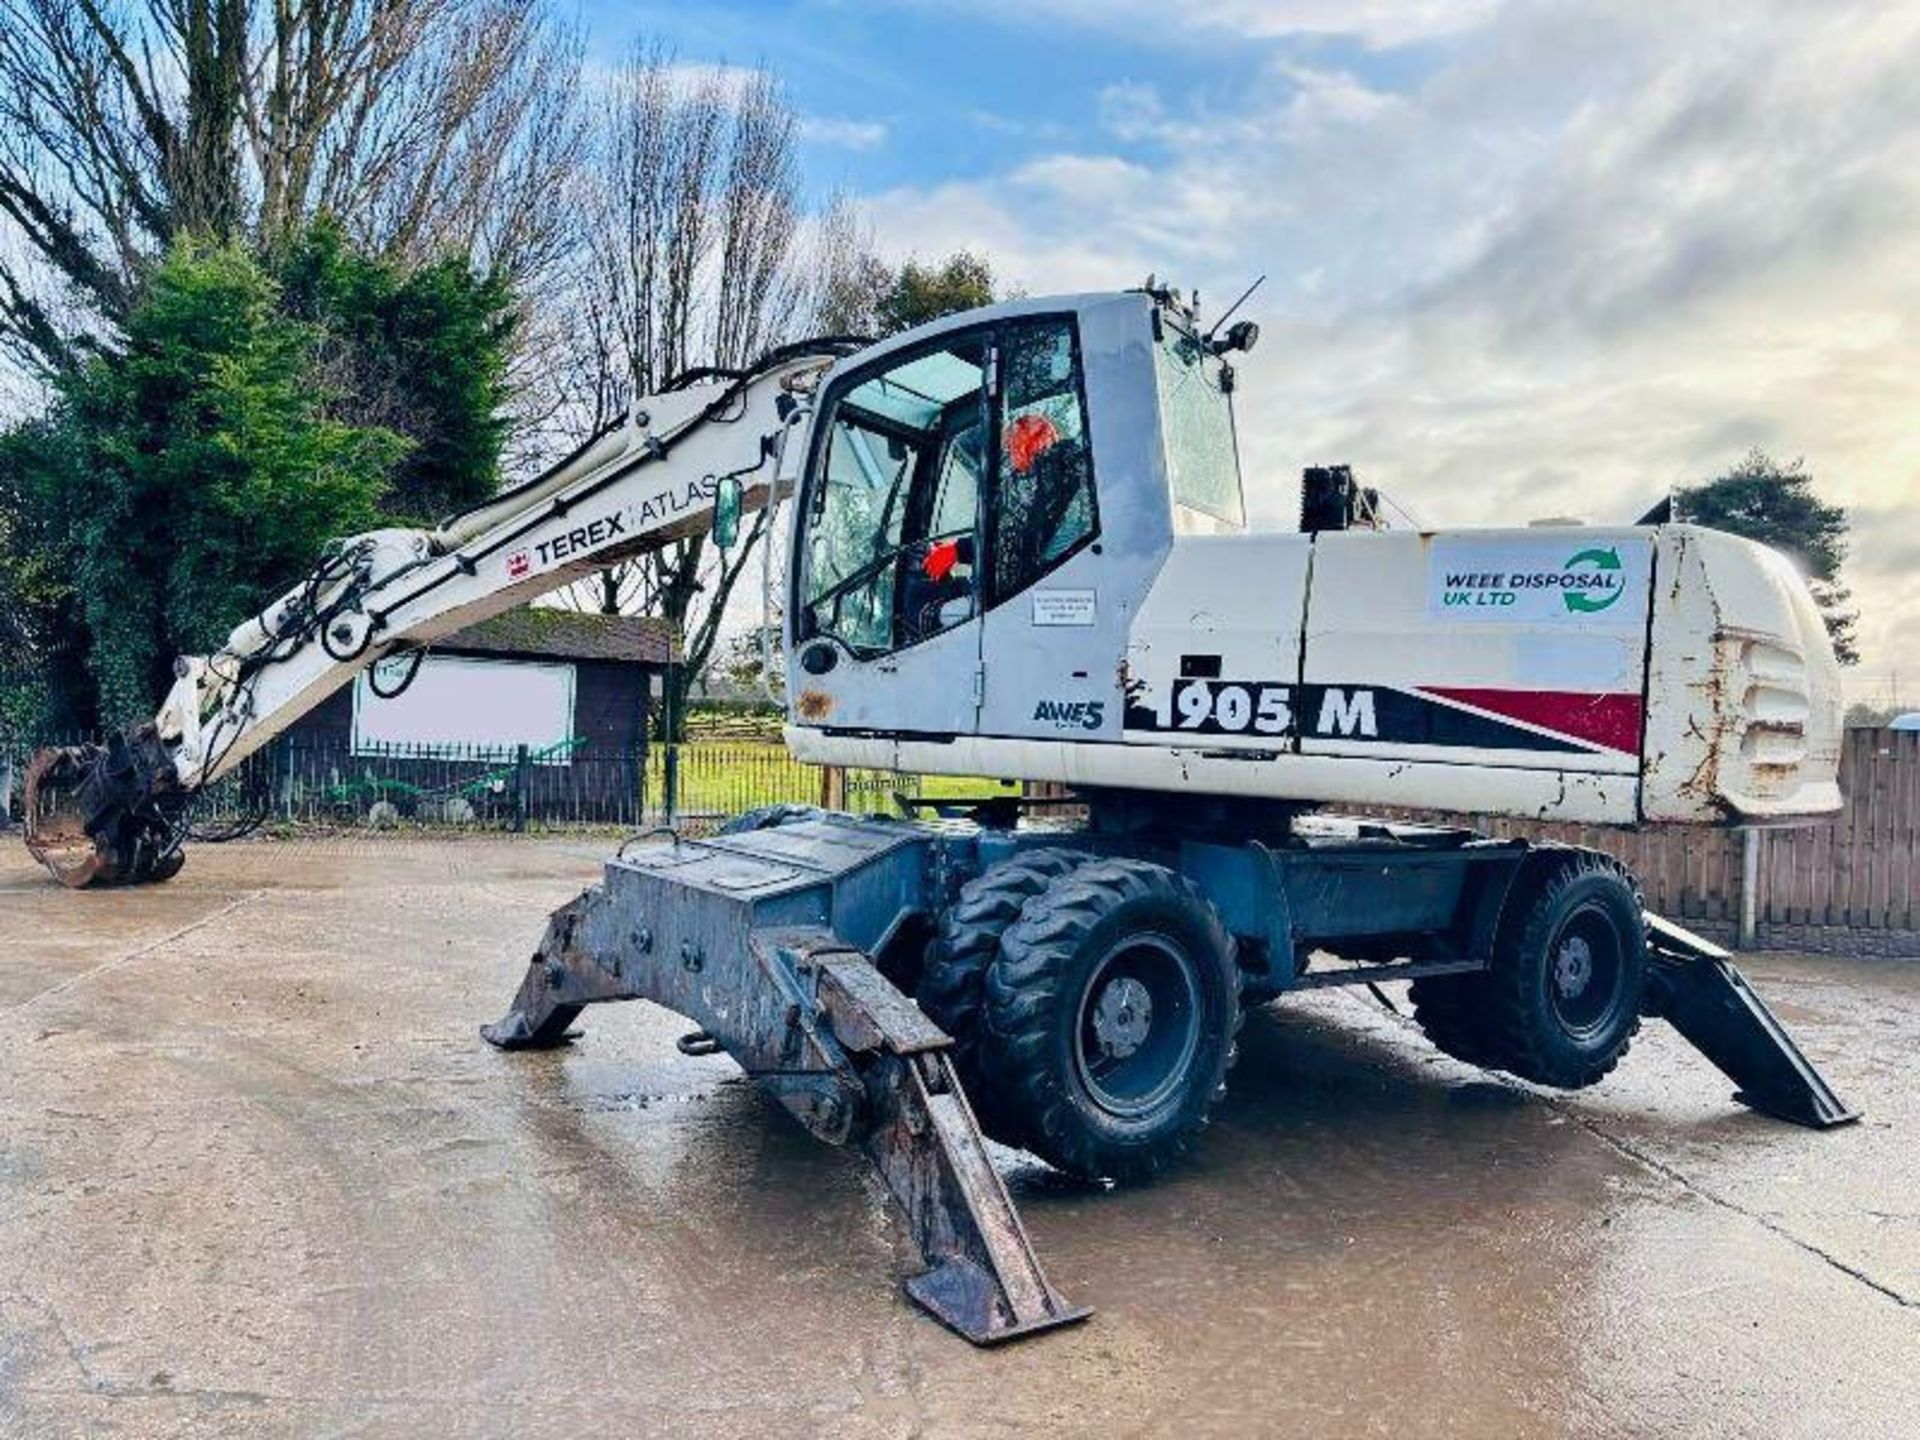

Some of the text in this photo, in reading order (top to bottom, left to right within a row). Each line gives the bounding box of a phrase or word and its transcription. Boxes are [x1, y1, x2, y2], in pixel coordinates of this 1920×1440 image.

[536, 474, 718, 565] TEREX ATLAS
[1445, 573, 1617, 589] WEEE DISPOSAL
[1444, 592, 1516, 606] UK LTD
[1146, 681, 1378, 736] 1905 M
